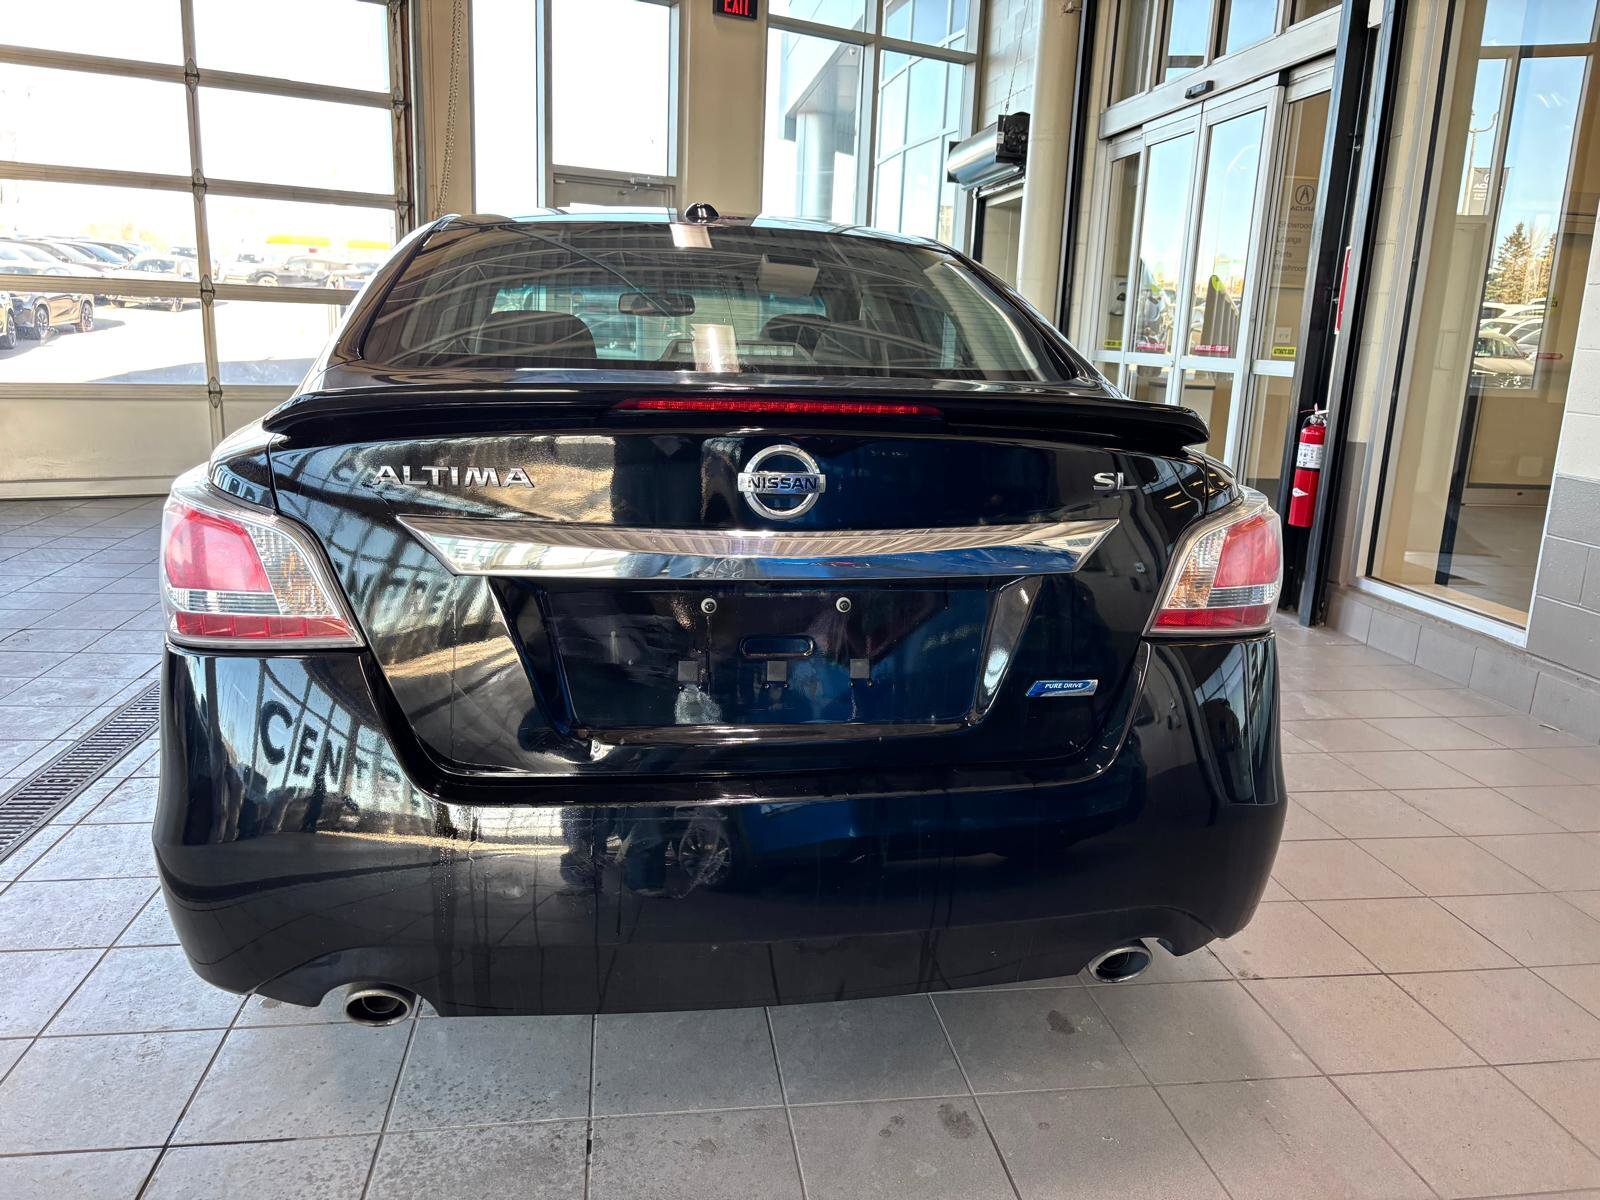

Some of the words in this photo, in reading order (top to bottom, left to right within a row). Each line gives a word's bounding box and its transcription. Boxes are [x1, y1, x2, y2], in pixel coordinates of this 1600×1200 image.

[1273, 263, 1308, 272] Washroo
[373, 465, 535, 488] ALTIMA
[748, 477, 817, 489] NISSAN
[1092, 471, 1138, 490] SL
